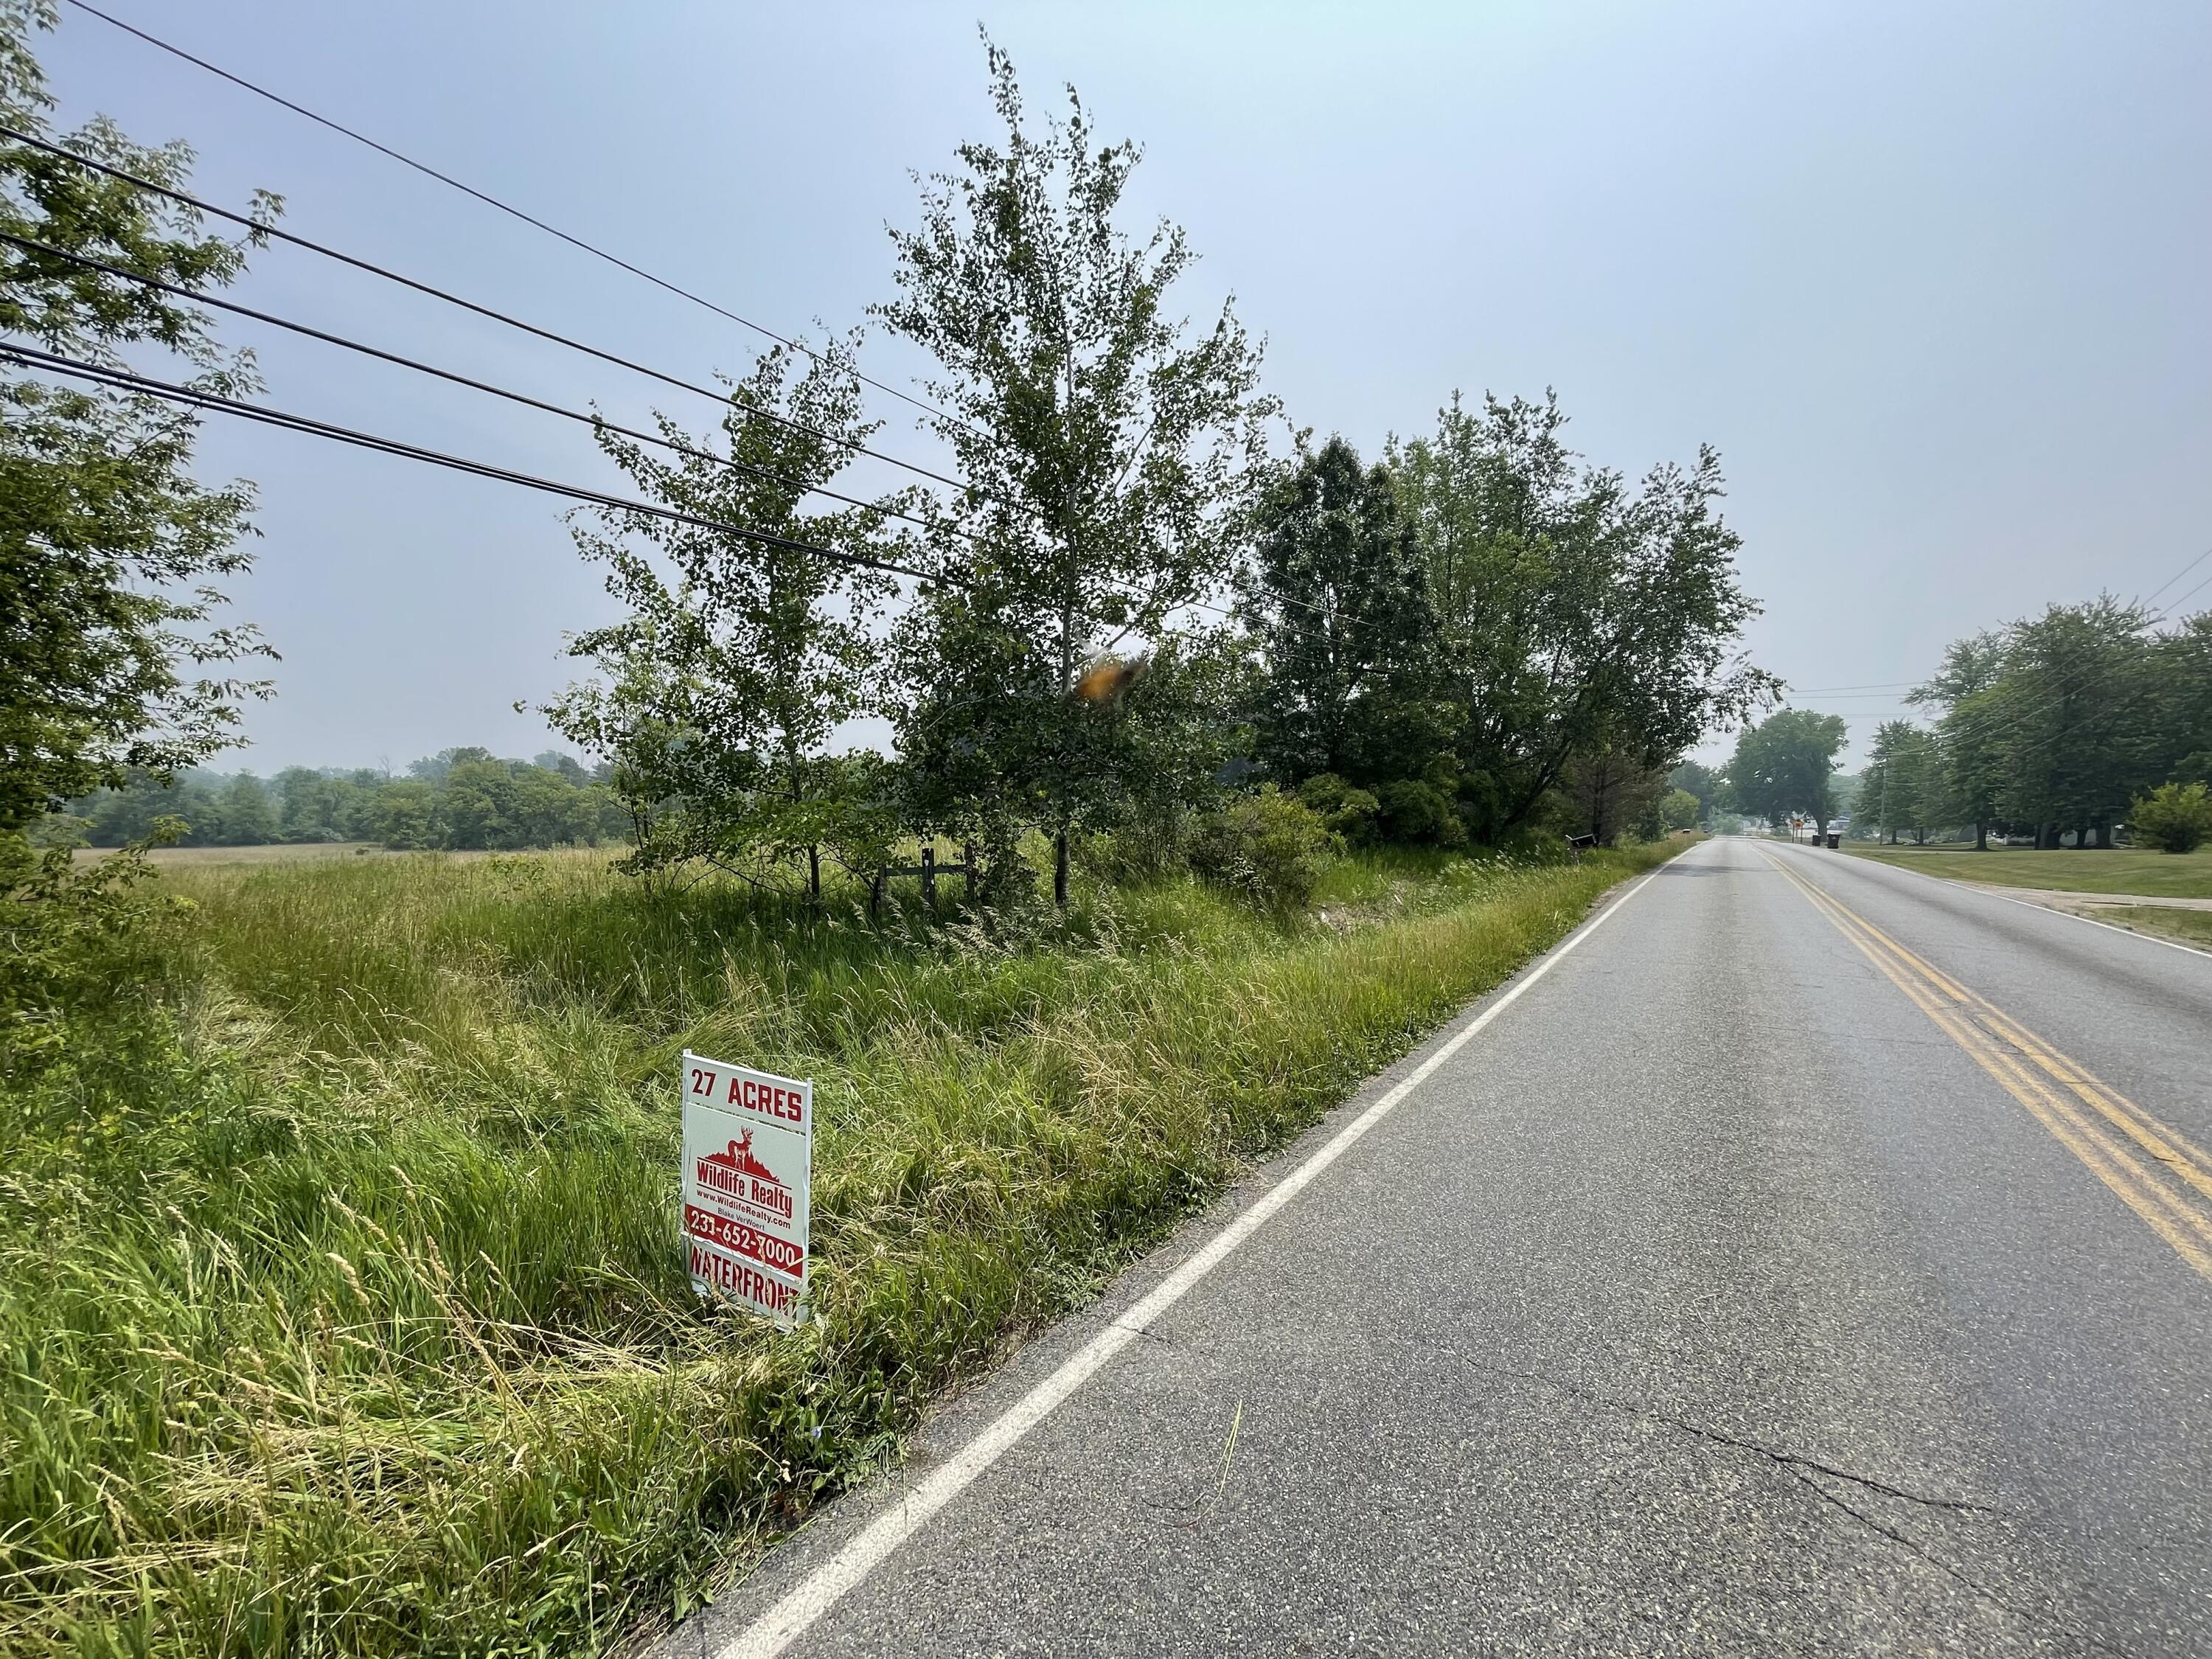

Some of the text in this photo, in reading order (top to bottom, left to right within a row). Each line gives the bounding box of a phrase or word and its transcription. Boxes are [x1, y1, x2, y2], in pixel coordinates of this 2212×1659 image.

[692, 1069, 801, 1121] 27 ACRES
[697, 1161, 792, 1219] Wildlife Realty
[697, 1189, 790, 1230] www.WildlifeRealty.com
[717, 1207, 734, 1219] Blake
[691, 1210, 795, 1266] 231-652-7000
